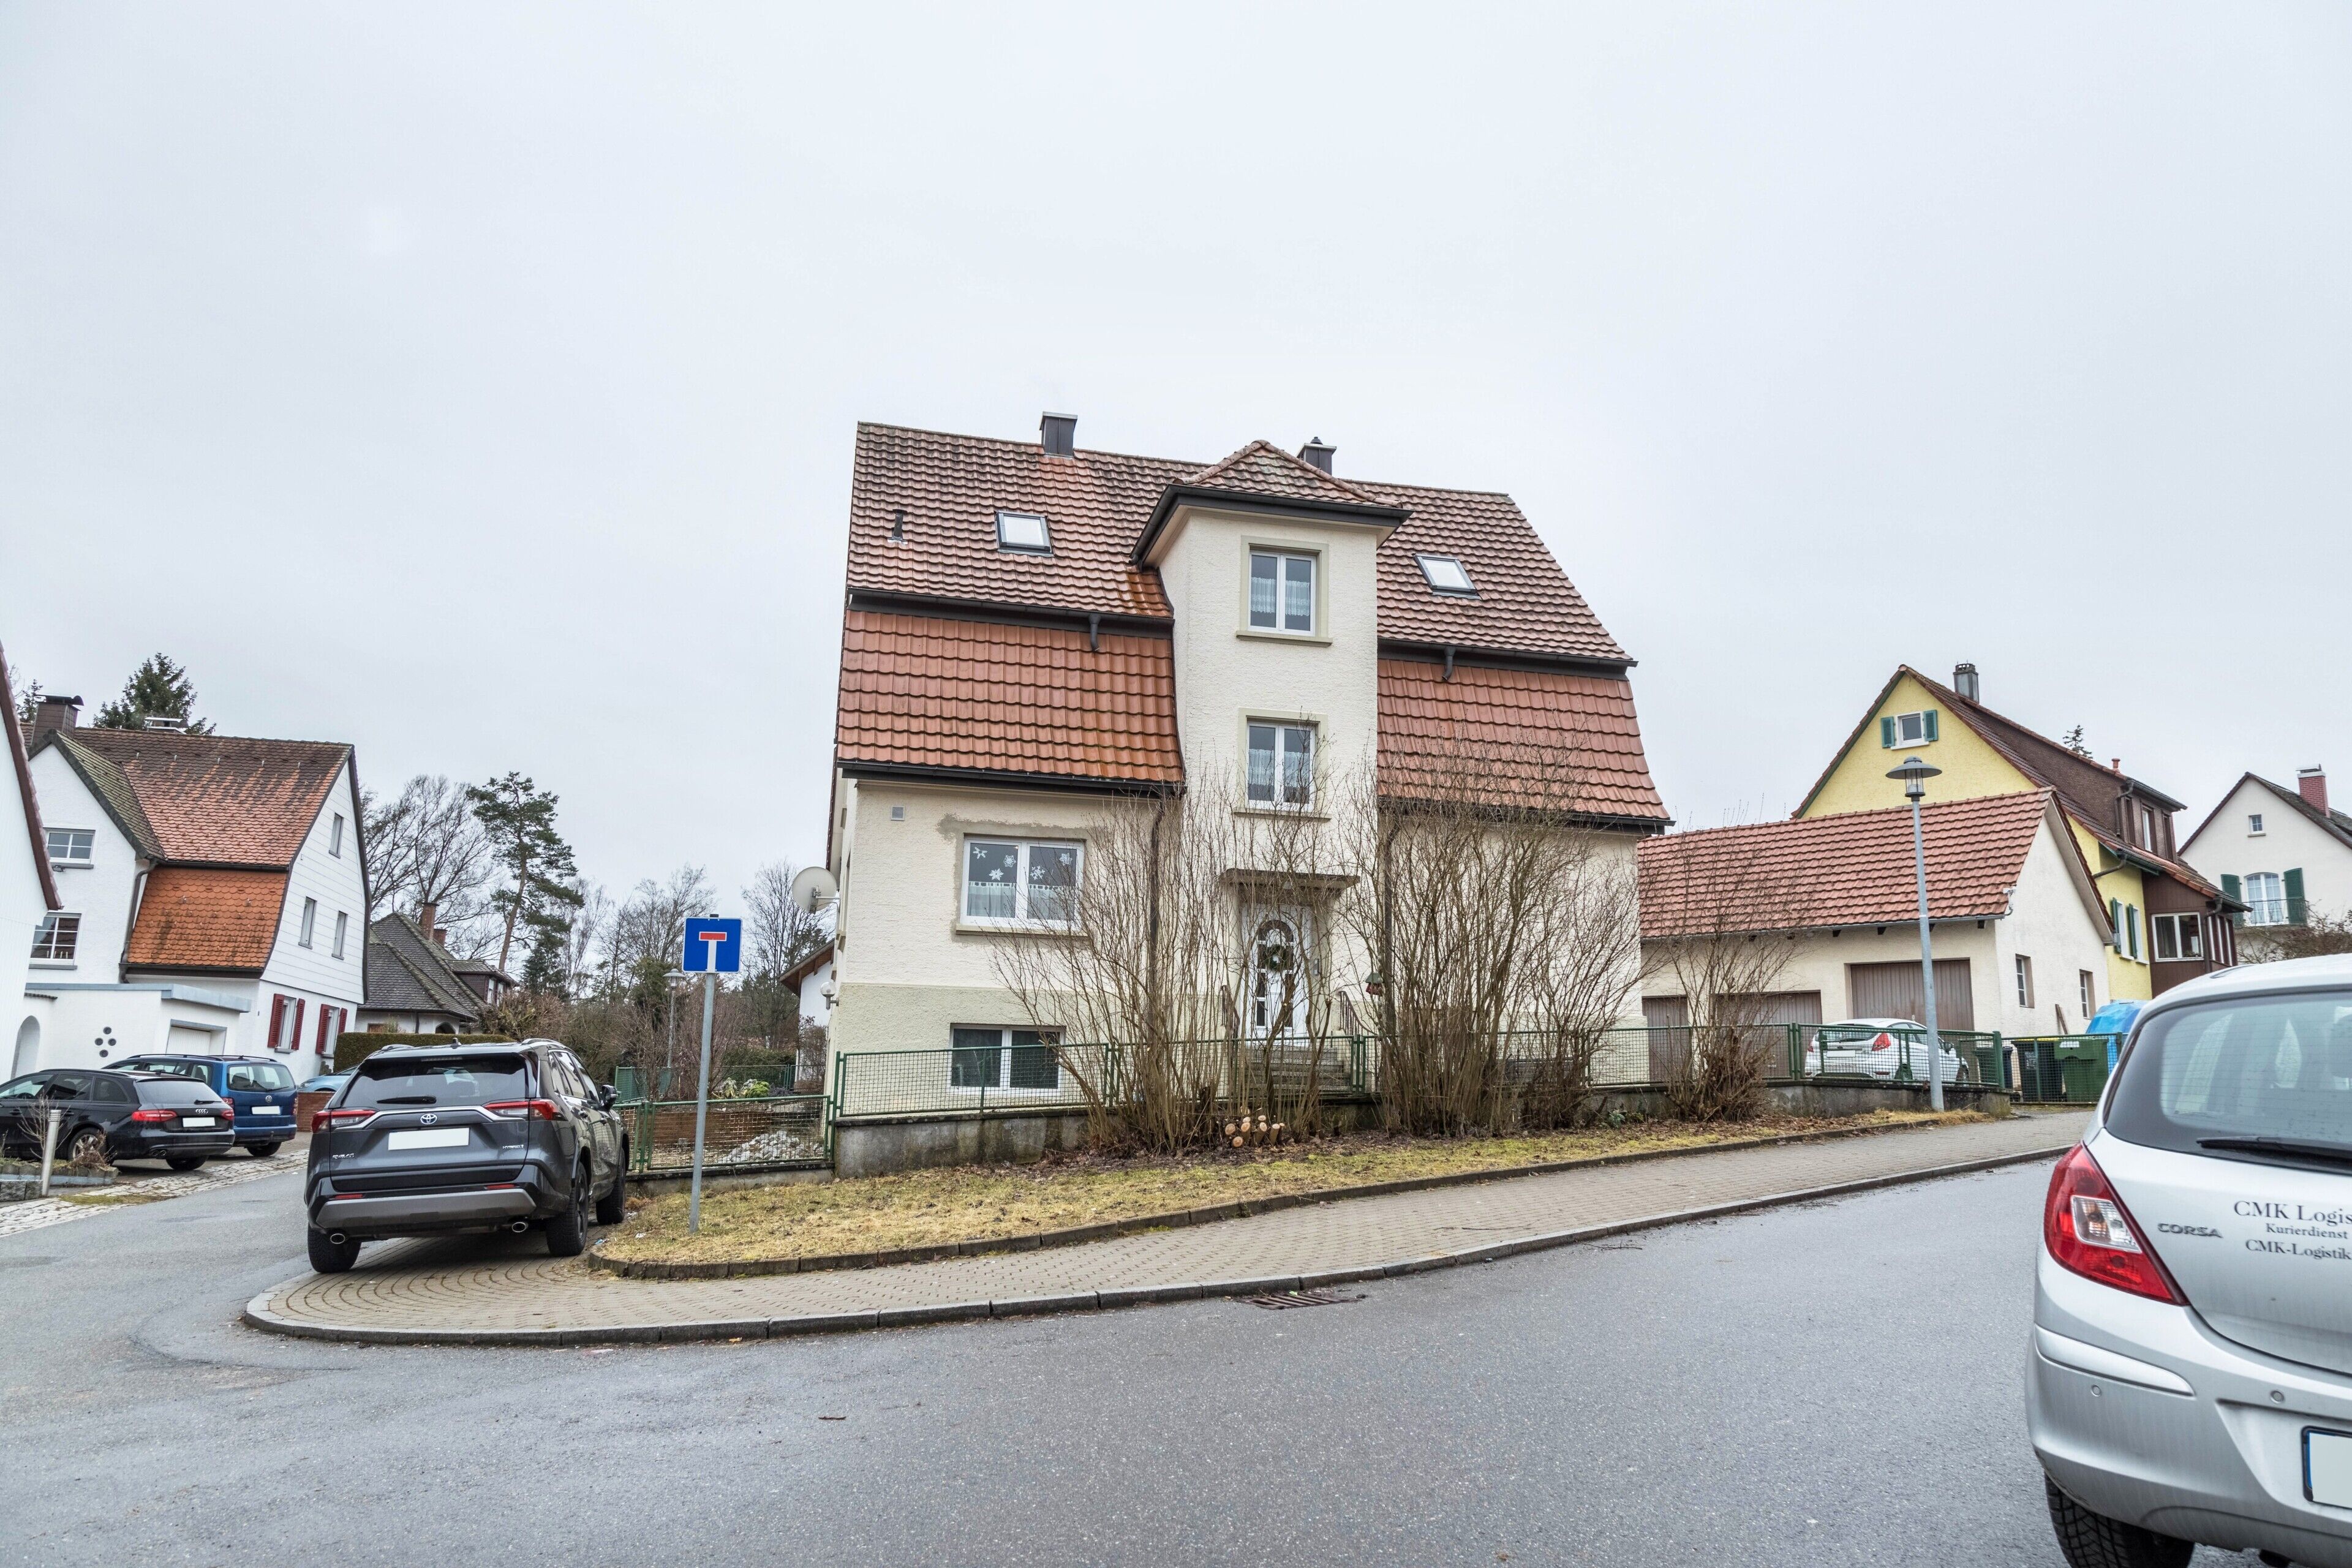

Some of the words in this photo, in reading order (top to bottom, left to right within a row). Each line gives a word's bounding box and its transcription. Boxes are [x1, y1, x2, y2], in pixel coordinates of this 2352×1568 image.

[2234, 1200, 2290, 1219] CMK
[2157, 1223, 2223, 1238] CORSA
[2266, 1223, 2348, 1240] Kurierdienst
